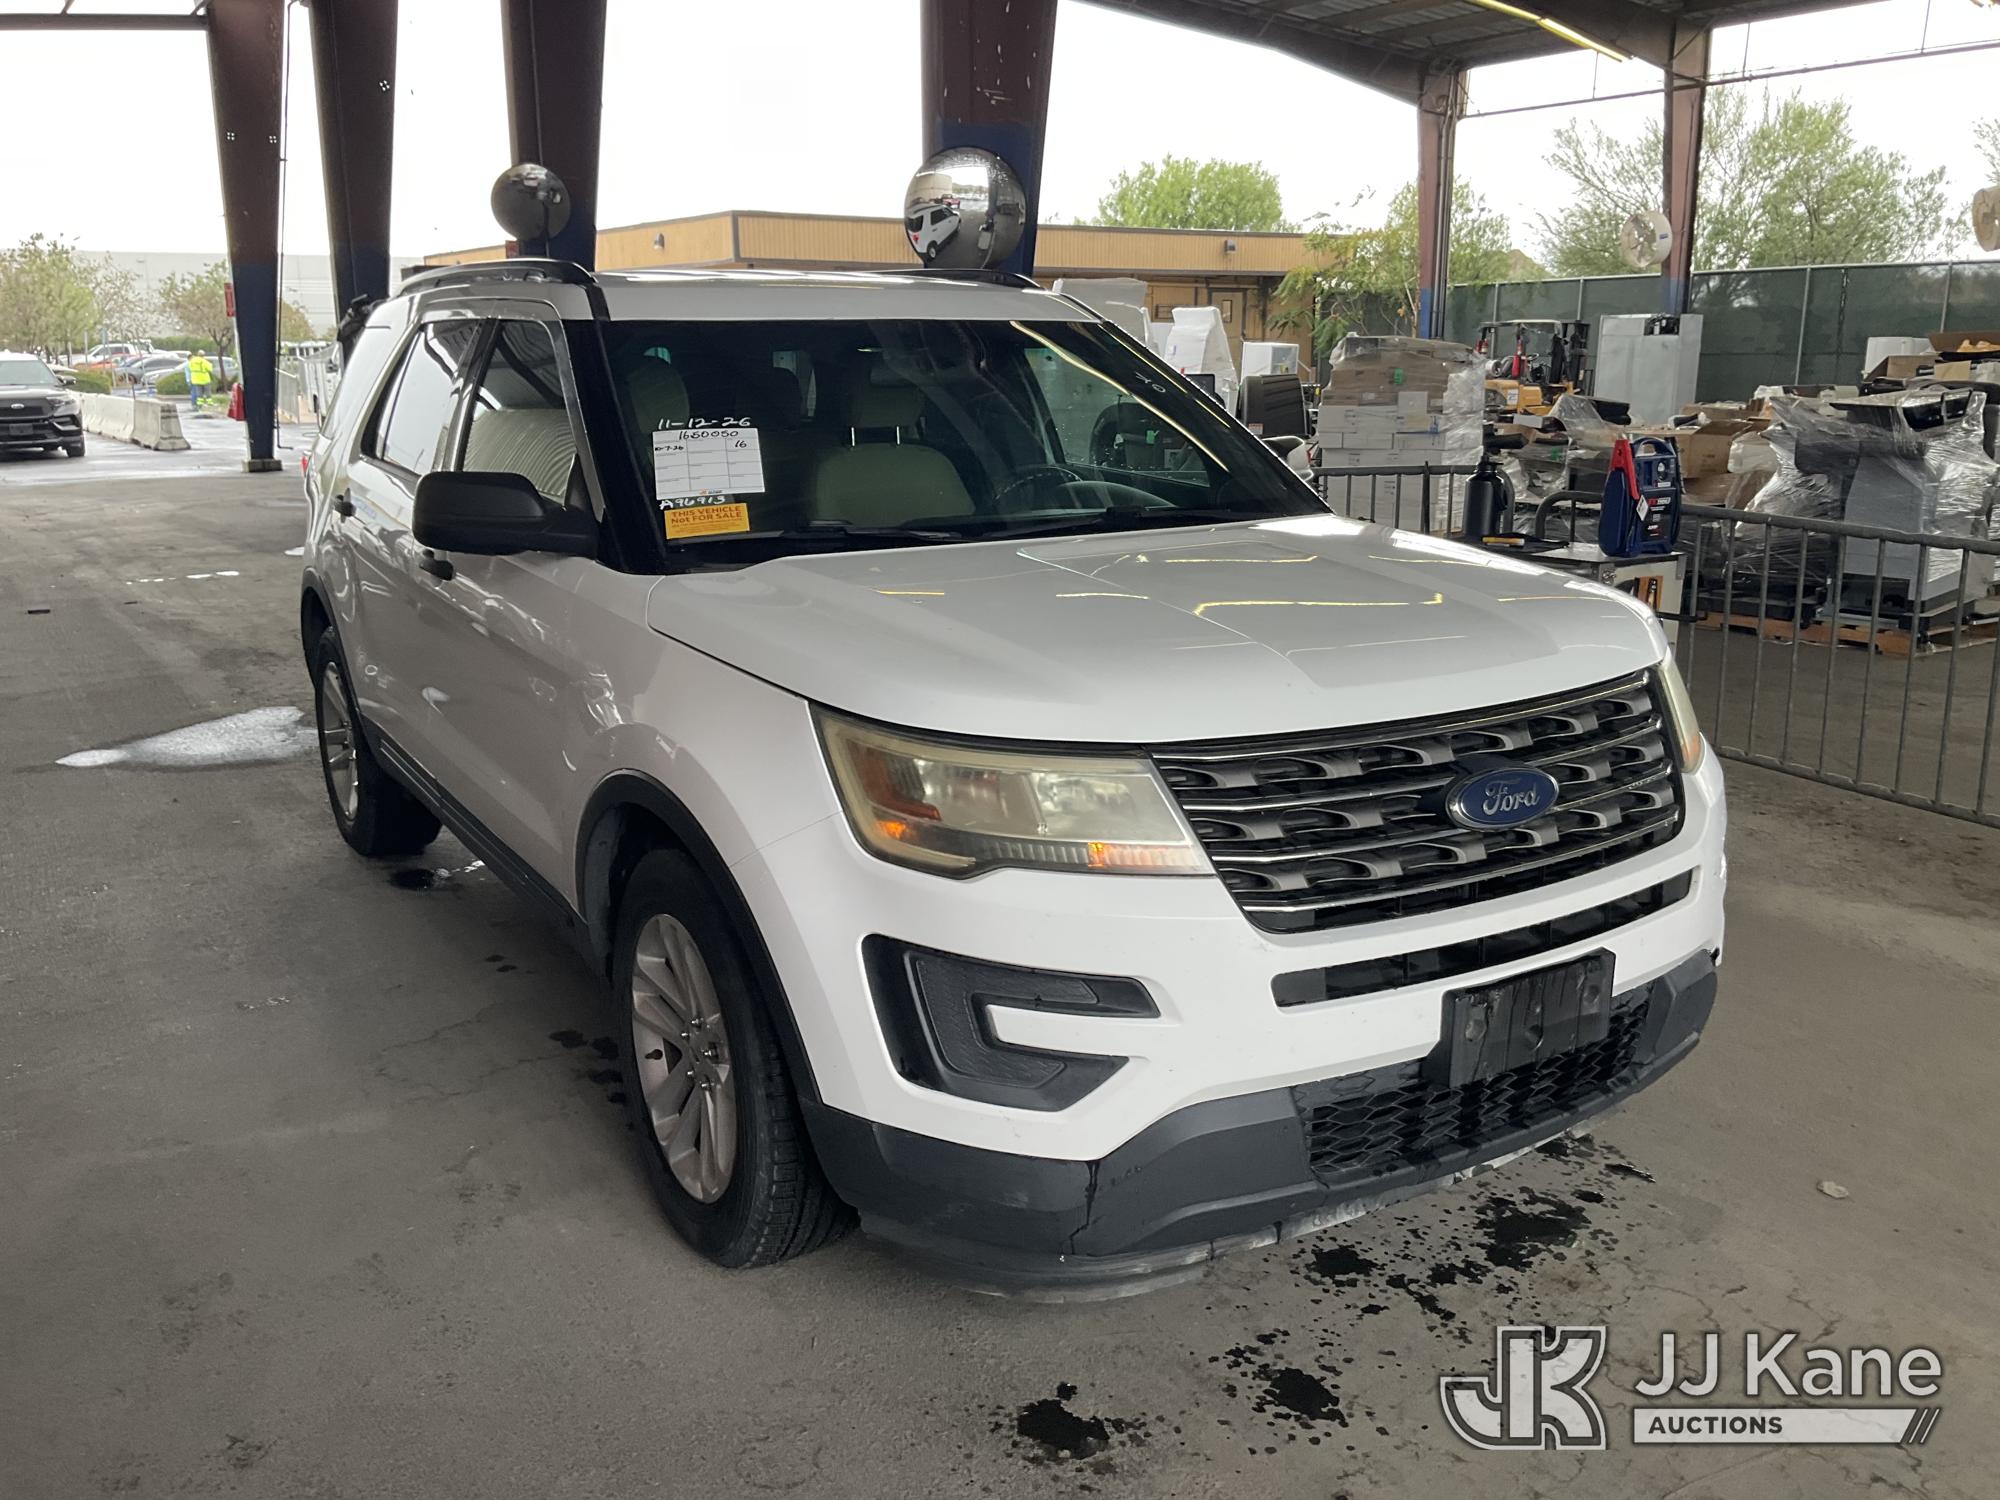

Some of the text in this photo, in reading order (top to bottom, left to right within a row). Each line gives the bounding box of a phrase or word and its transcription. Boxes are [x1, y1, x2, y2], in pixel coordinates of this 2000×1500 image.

[735, 440, 747, 448] 16
[671, 505, 741, 518] THIS VEHICLE
[692, 514, 713, 522] FOR
[717, 511, 743, 519] SALE
[1483, 779, 1540, 815] Ford
